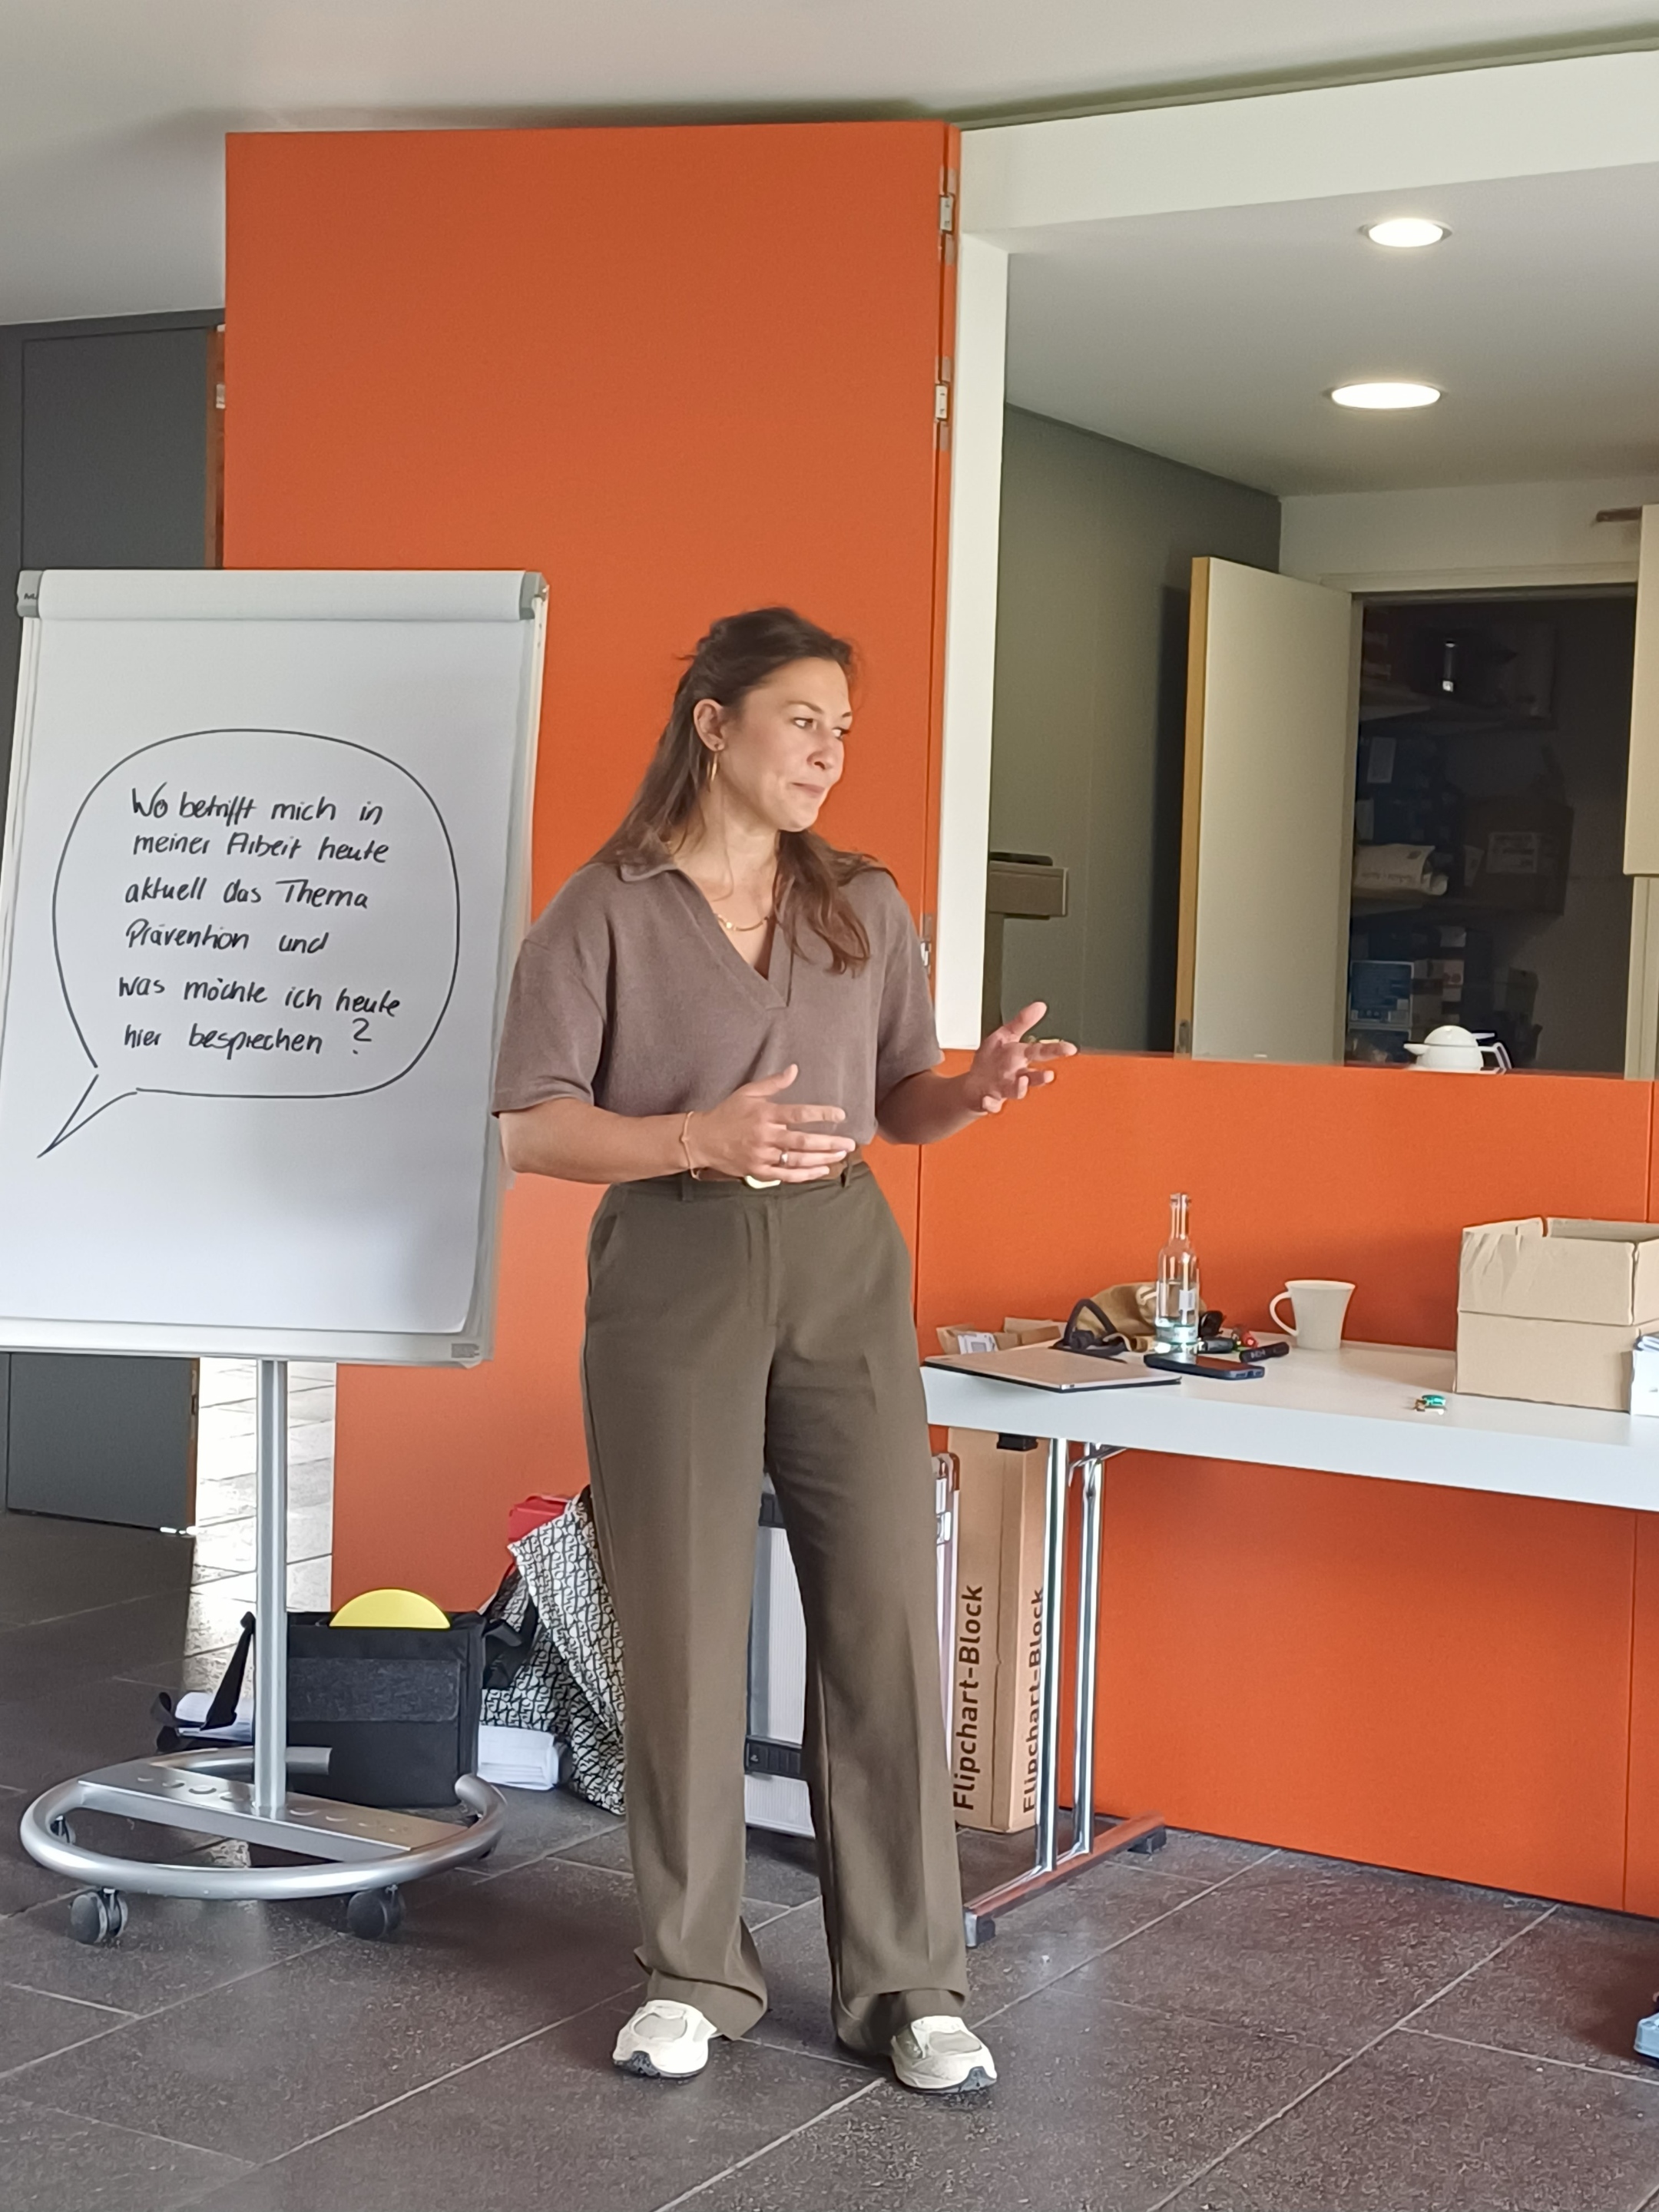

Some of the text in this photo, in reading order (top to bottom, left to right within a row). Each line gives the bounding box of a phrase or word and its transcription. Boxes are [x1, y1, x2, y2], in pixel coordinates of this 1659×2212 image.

[132, 782, 383, 827] Wo betrifft mich in
[133, 831, 389, 863] meiner Arbeit heute
[124, 876, 369, 909] aktuell das Thema
[125, 918, 329, 954] Prävention und
[184, 977, 268, 1004] möchte
[284, 986, 323, 1012] ich
[335, 988, 401, 1018] heute
[124, 1018, 373, 1060] hier besprechen ?
[953, 1584, 983, 1810] Flipchart-Block
